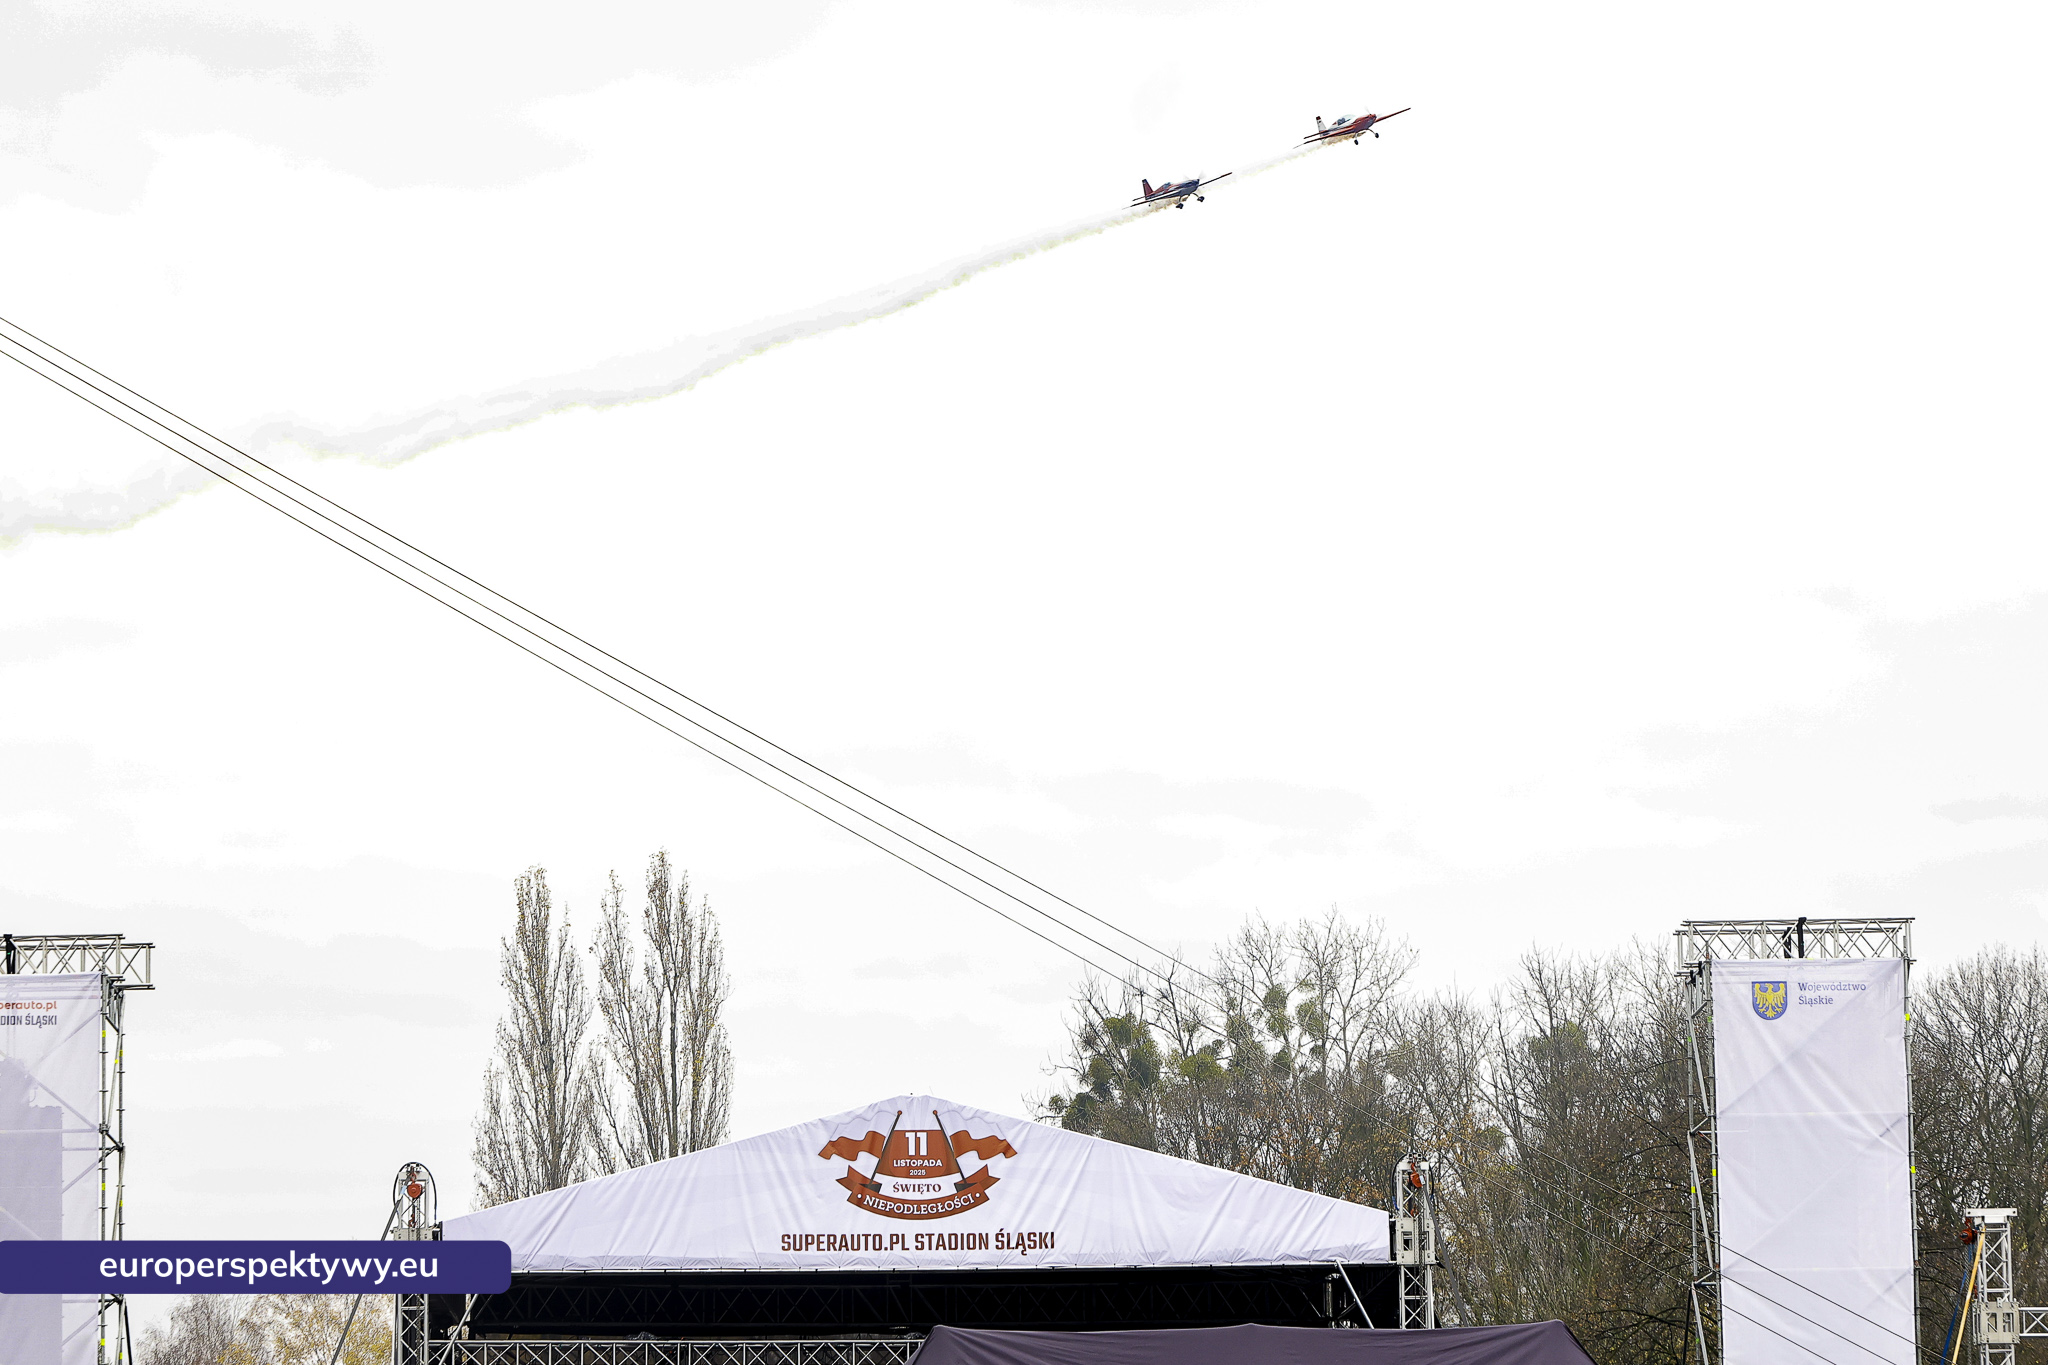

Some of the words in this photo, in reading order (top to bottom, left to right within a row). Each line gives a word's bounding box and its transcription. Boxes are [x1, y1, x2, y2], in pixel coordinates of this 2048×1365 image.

[1798, 982, 1867, 993] Województwo
[1798, 994, 1834, 1007] Śląskie
[25, 1013, 57, 1028] ŚLĄSKI
[905, 1131, 928, 1156] 11
[893, 1159, 942, 1167] LISTOPADA
[893, 1182, 942, 1195] ŚWIĘTO
[863, 1193, 975, 1215] NIEPODLEGŁOŚCI
[781, 1233, 910, 1251] SUPERAUTO.PL
[914, 1232, 989, 1250] STADION
[995, 1228, 1055, 1256] ŚLĄSKI
